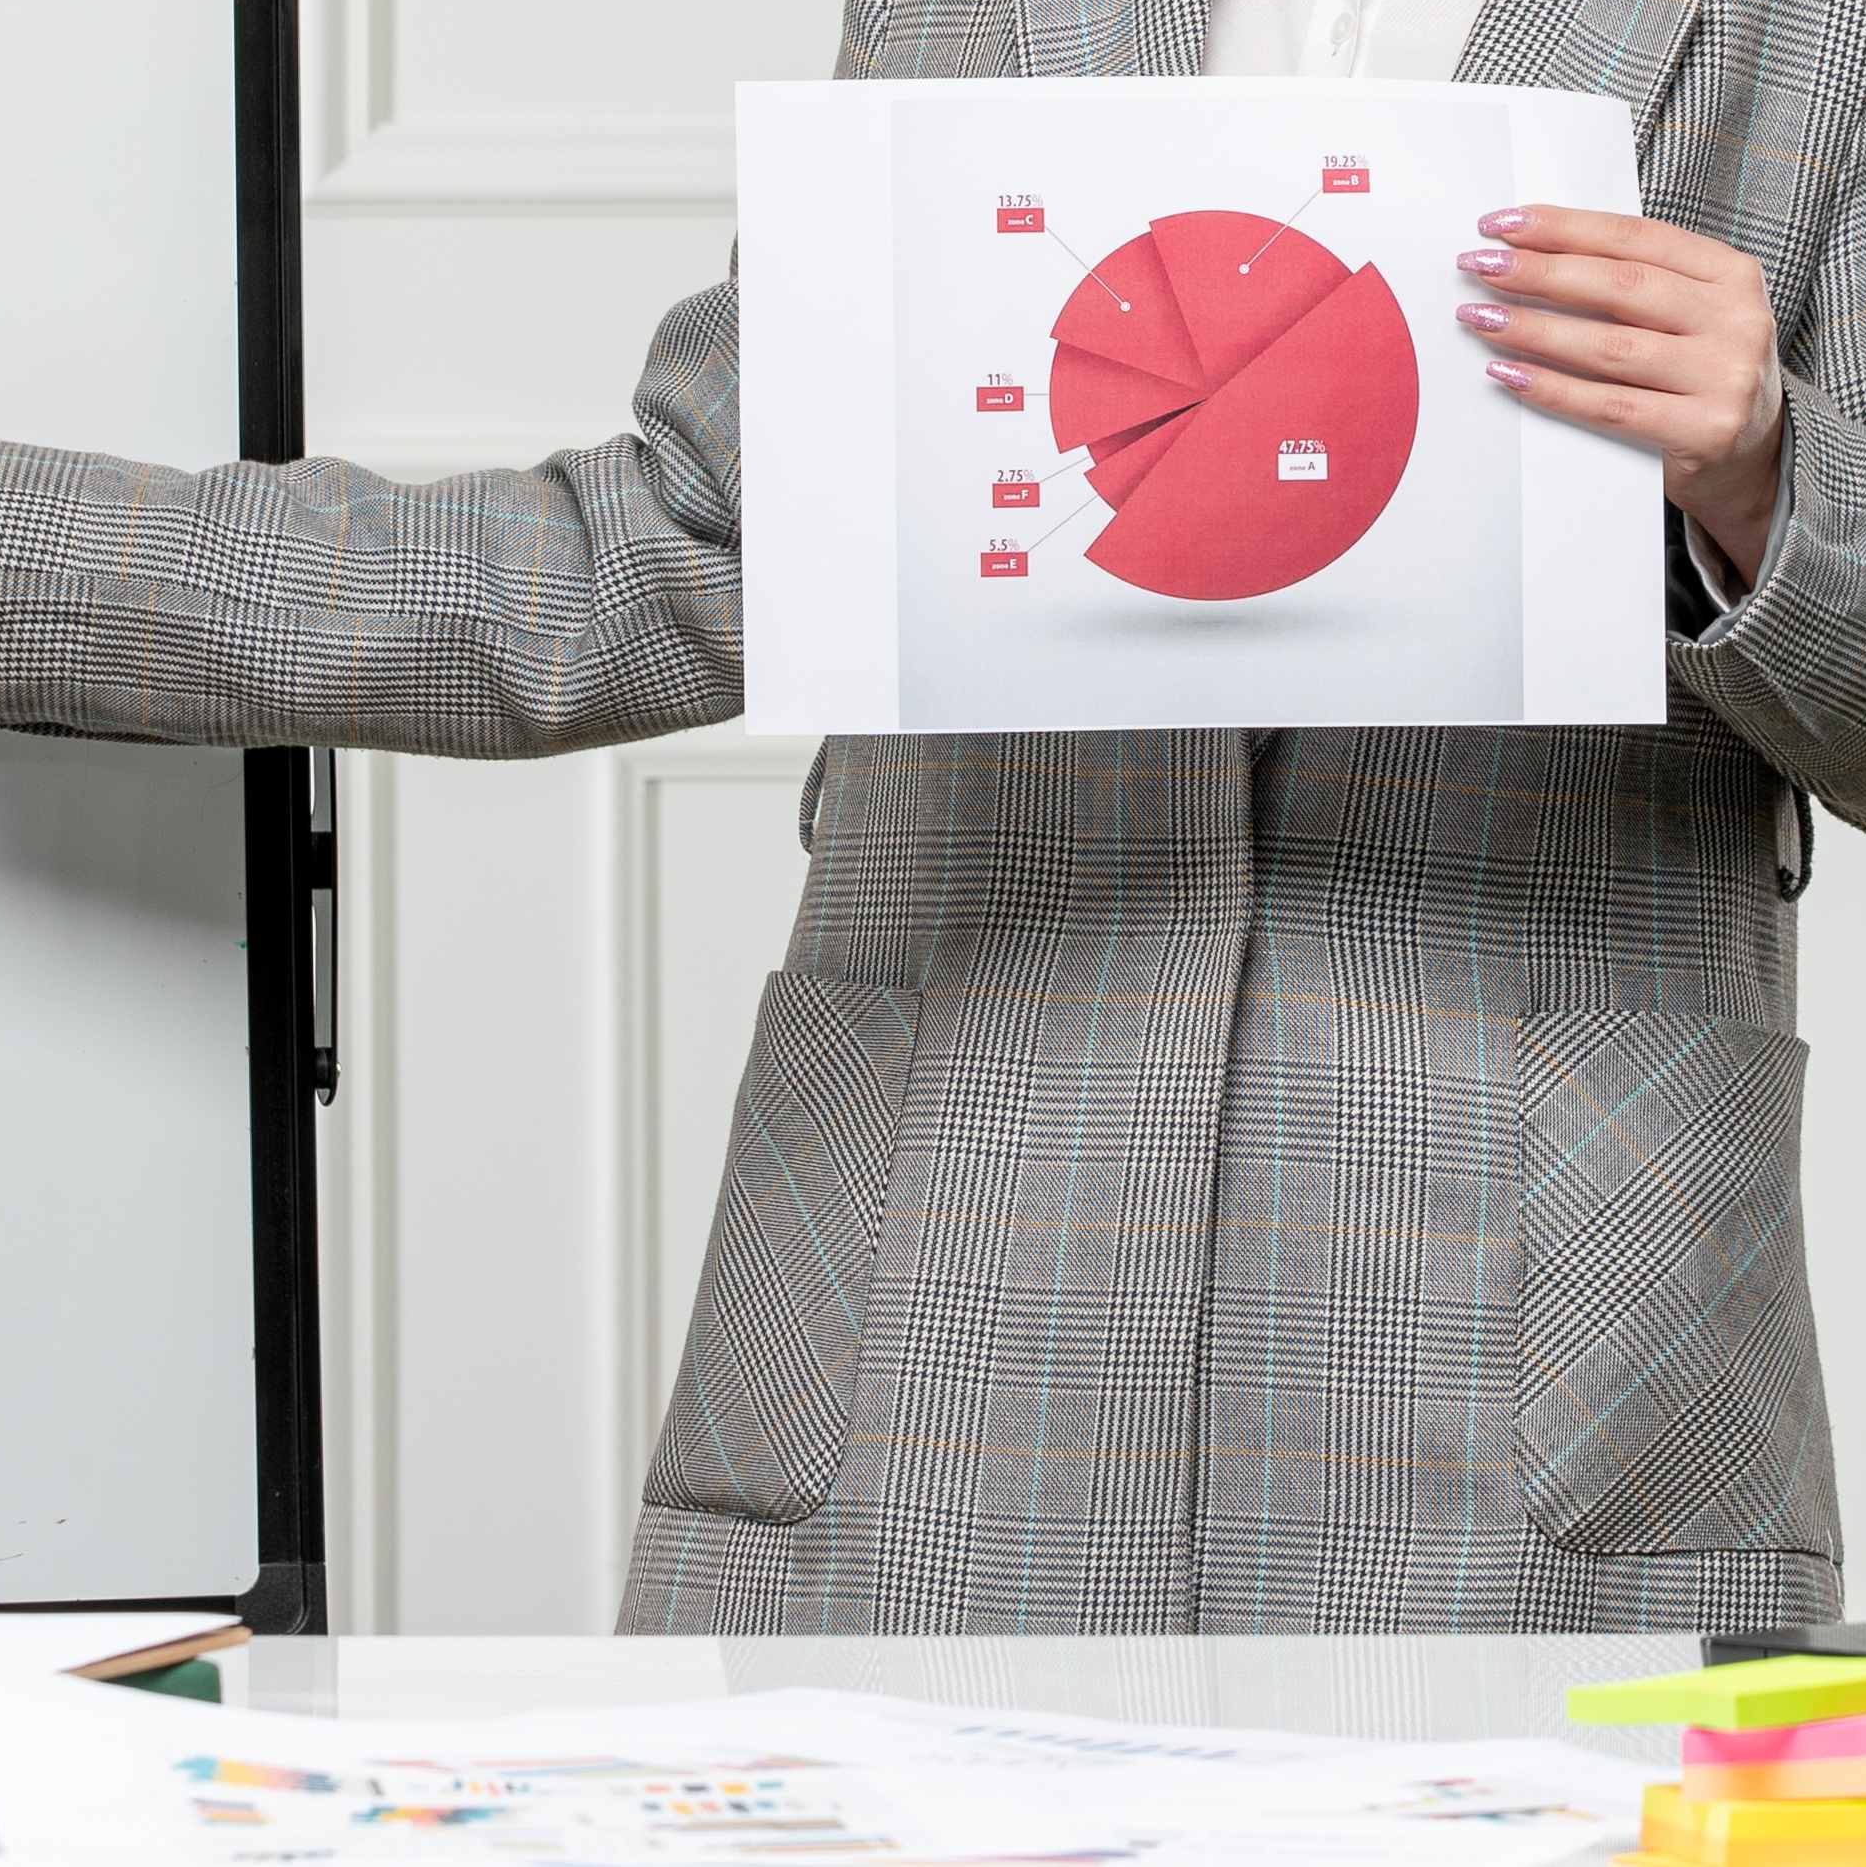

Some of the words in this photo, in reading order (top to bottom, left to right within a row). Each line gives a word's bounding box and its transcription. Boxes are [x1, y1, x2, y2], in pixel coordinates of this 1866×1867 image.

[998, 195, 1044, 208] 13.75%
[987, 374, 1013, 386] 11%
[1279, 440, 1325, 454] 47.75%
[997, 470, 1035, 482] 2.75%
[989, 539, 1020, 552] 5.5%
